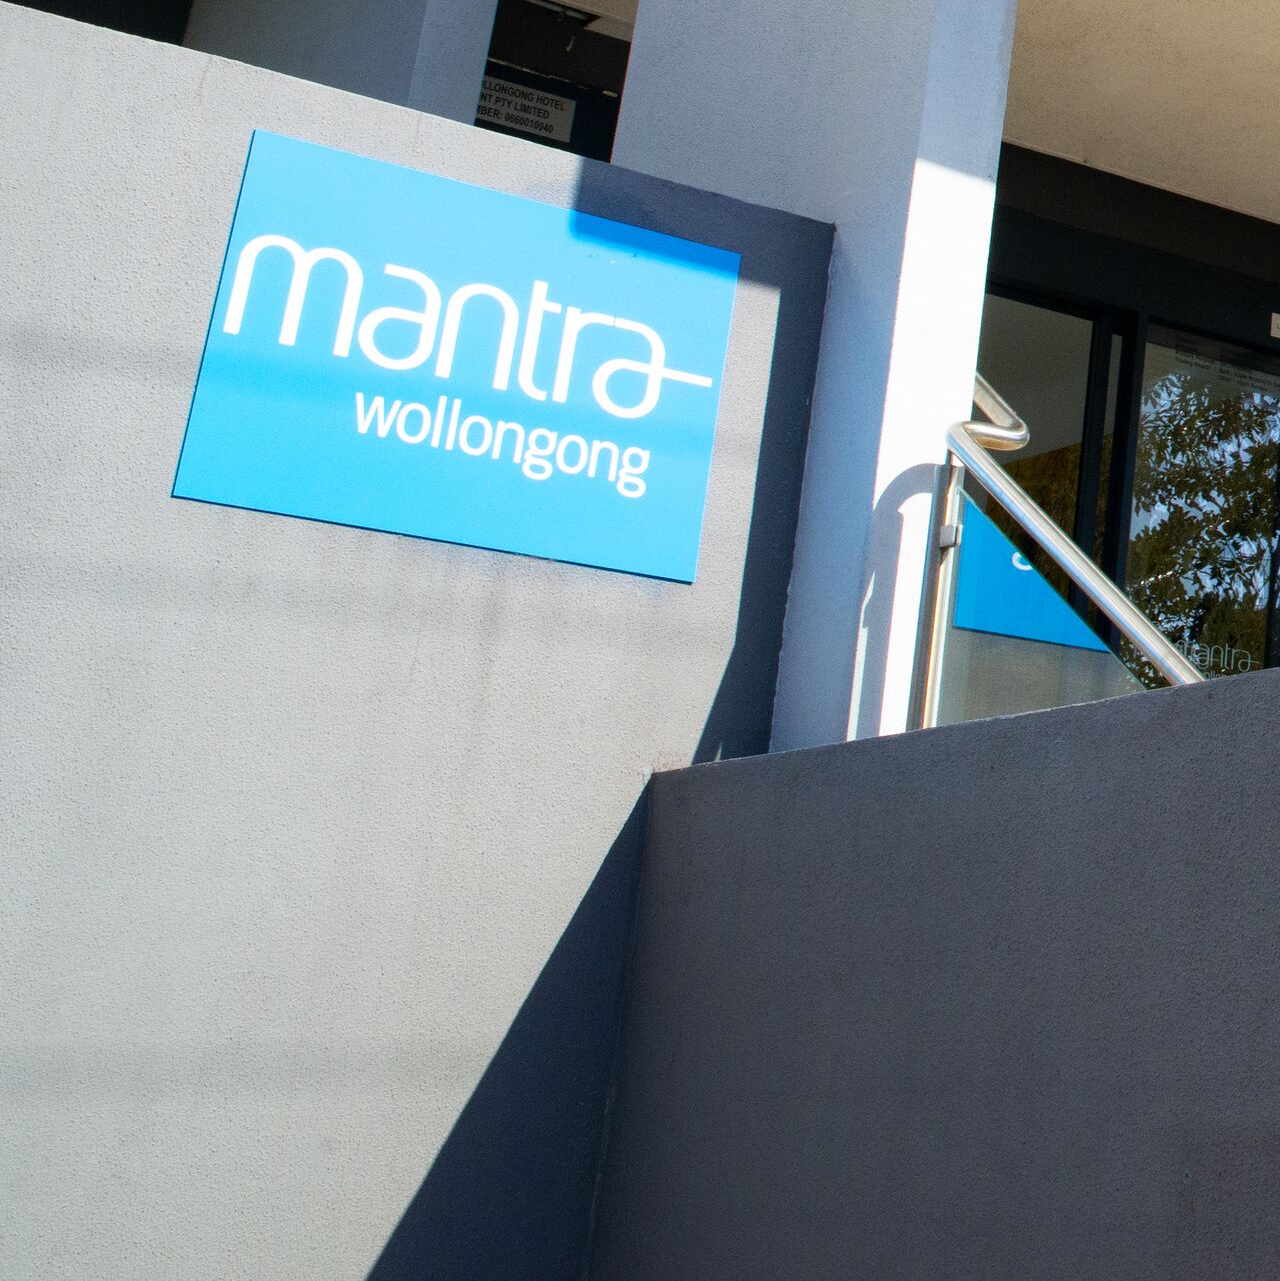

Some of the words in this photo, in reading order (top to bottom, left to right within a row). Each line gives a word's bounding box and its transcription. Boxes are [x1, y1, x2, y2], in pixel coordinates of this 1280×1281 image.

[483, 80, 535, 101] LLONGONG
[536, 95, 566, 111] HOTEL
[495, 96, 512, 108] PTY
[514, 101, 550, 120] LIMITED
[480, 105, 503, 120] BER:
[223, 233, 713, 419] mantra
[355, 391, 651, 498] wollongong
